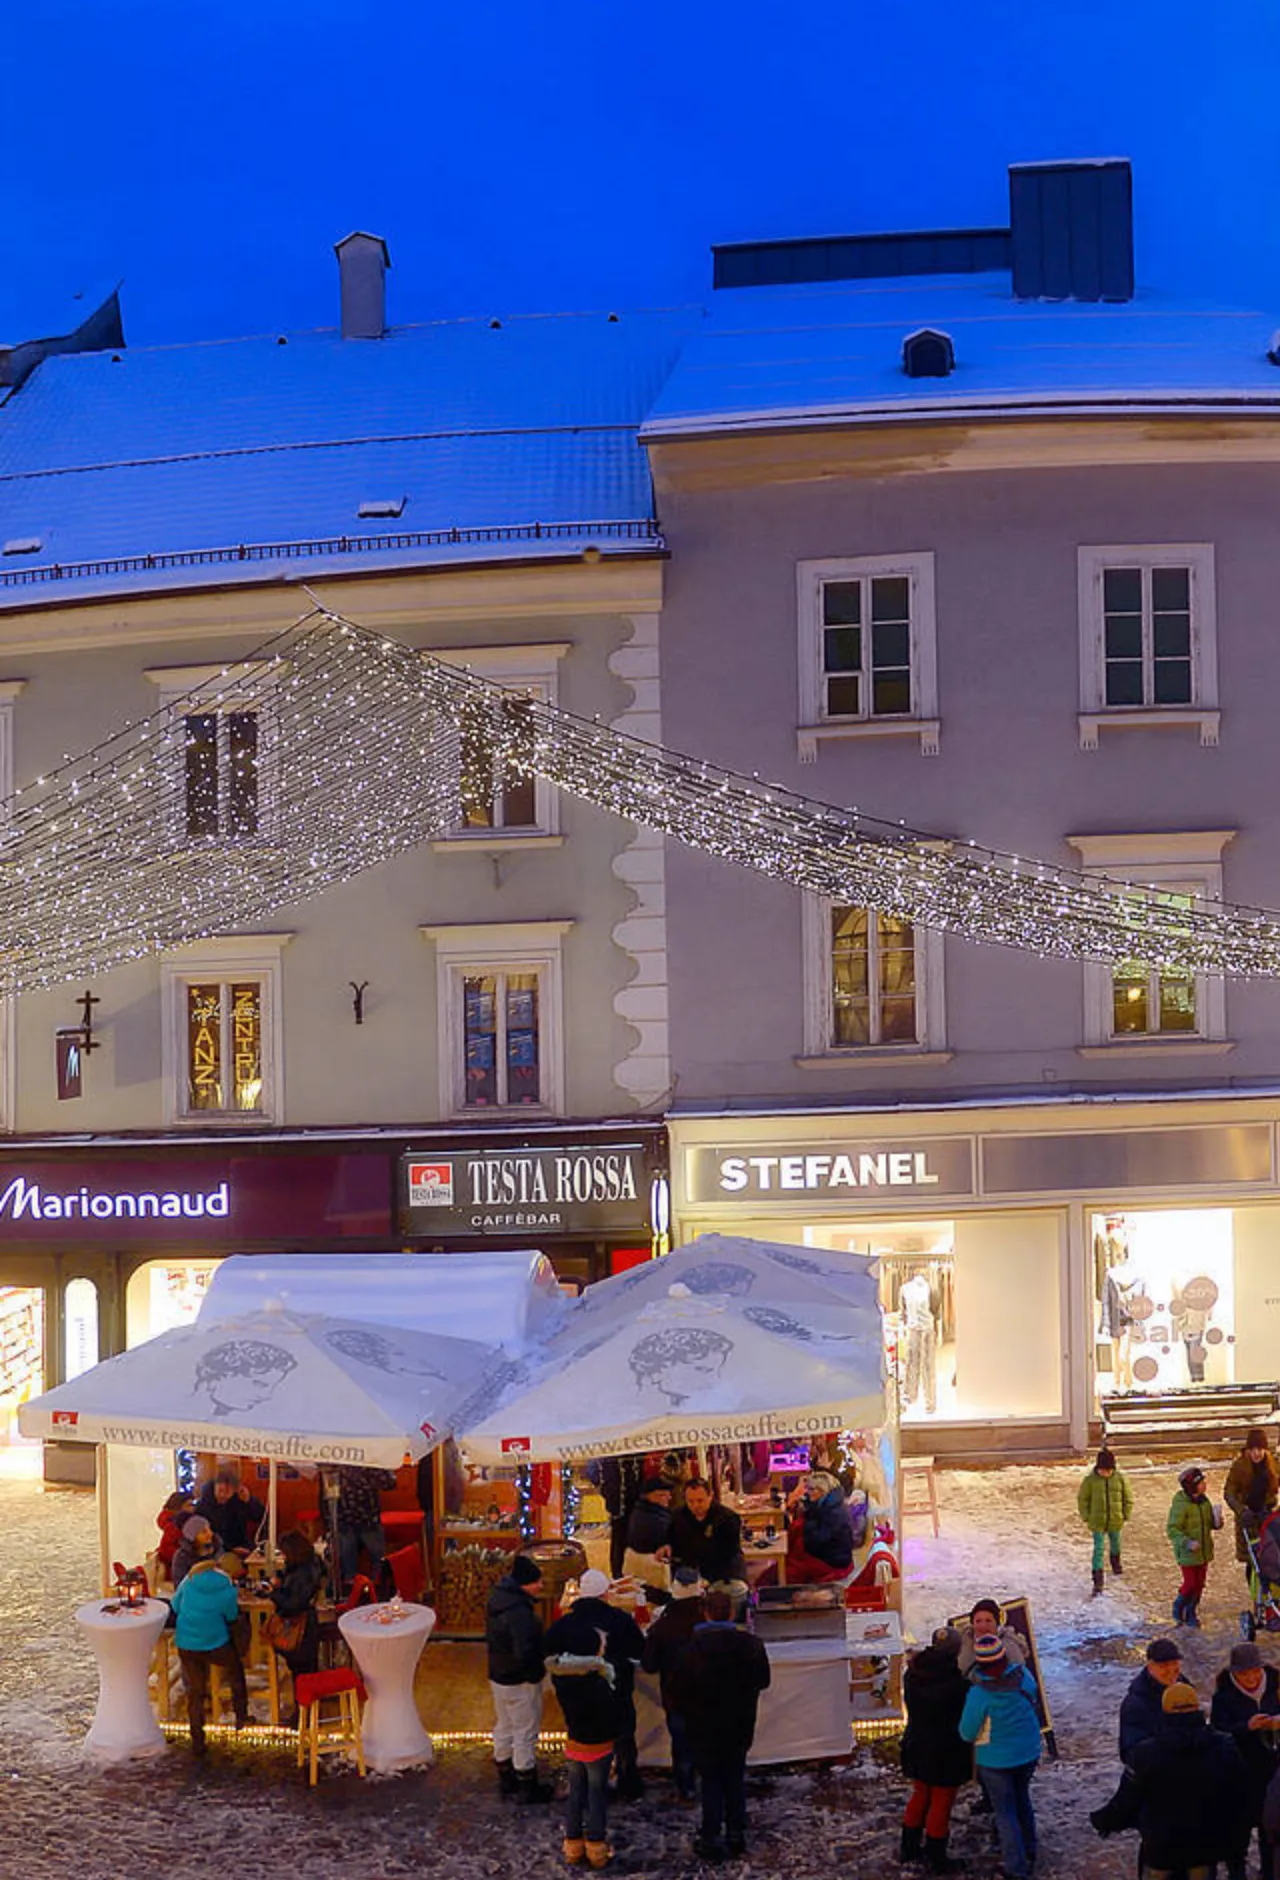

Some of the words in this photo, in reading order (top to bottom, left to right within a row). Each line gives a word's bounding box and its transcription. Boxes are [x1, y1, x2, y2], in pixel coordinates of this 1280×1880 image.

[235, 991, 255, 1098] ZENTRU
[468, 1158, 548, 1205] TESTA
[555, 1155, 637, 1202] ROSSA
[719, 1152, 938, 1191] STEFANEL
[0, 1177, 229, 1219] Marionnaud
[471, 1212, 561, 1227] CAFFÈBAR
[101, 1424, 366, 1462] www.testarossacaffe.com
[558, 1412, 844, 1459] www.testarossacaffe.com
